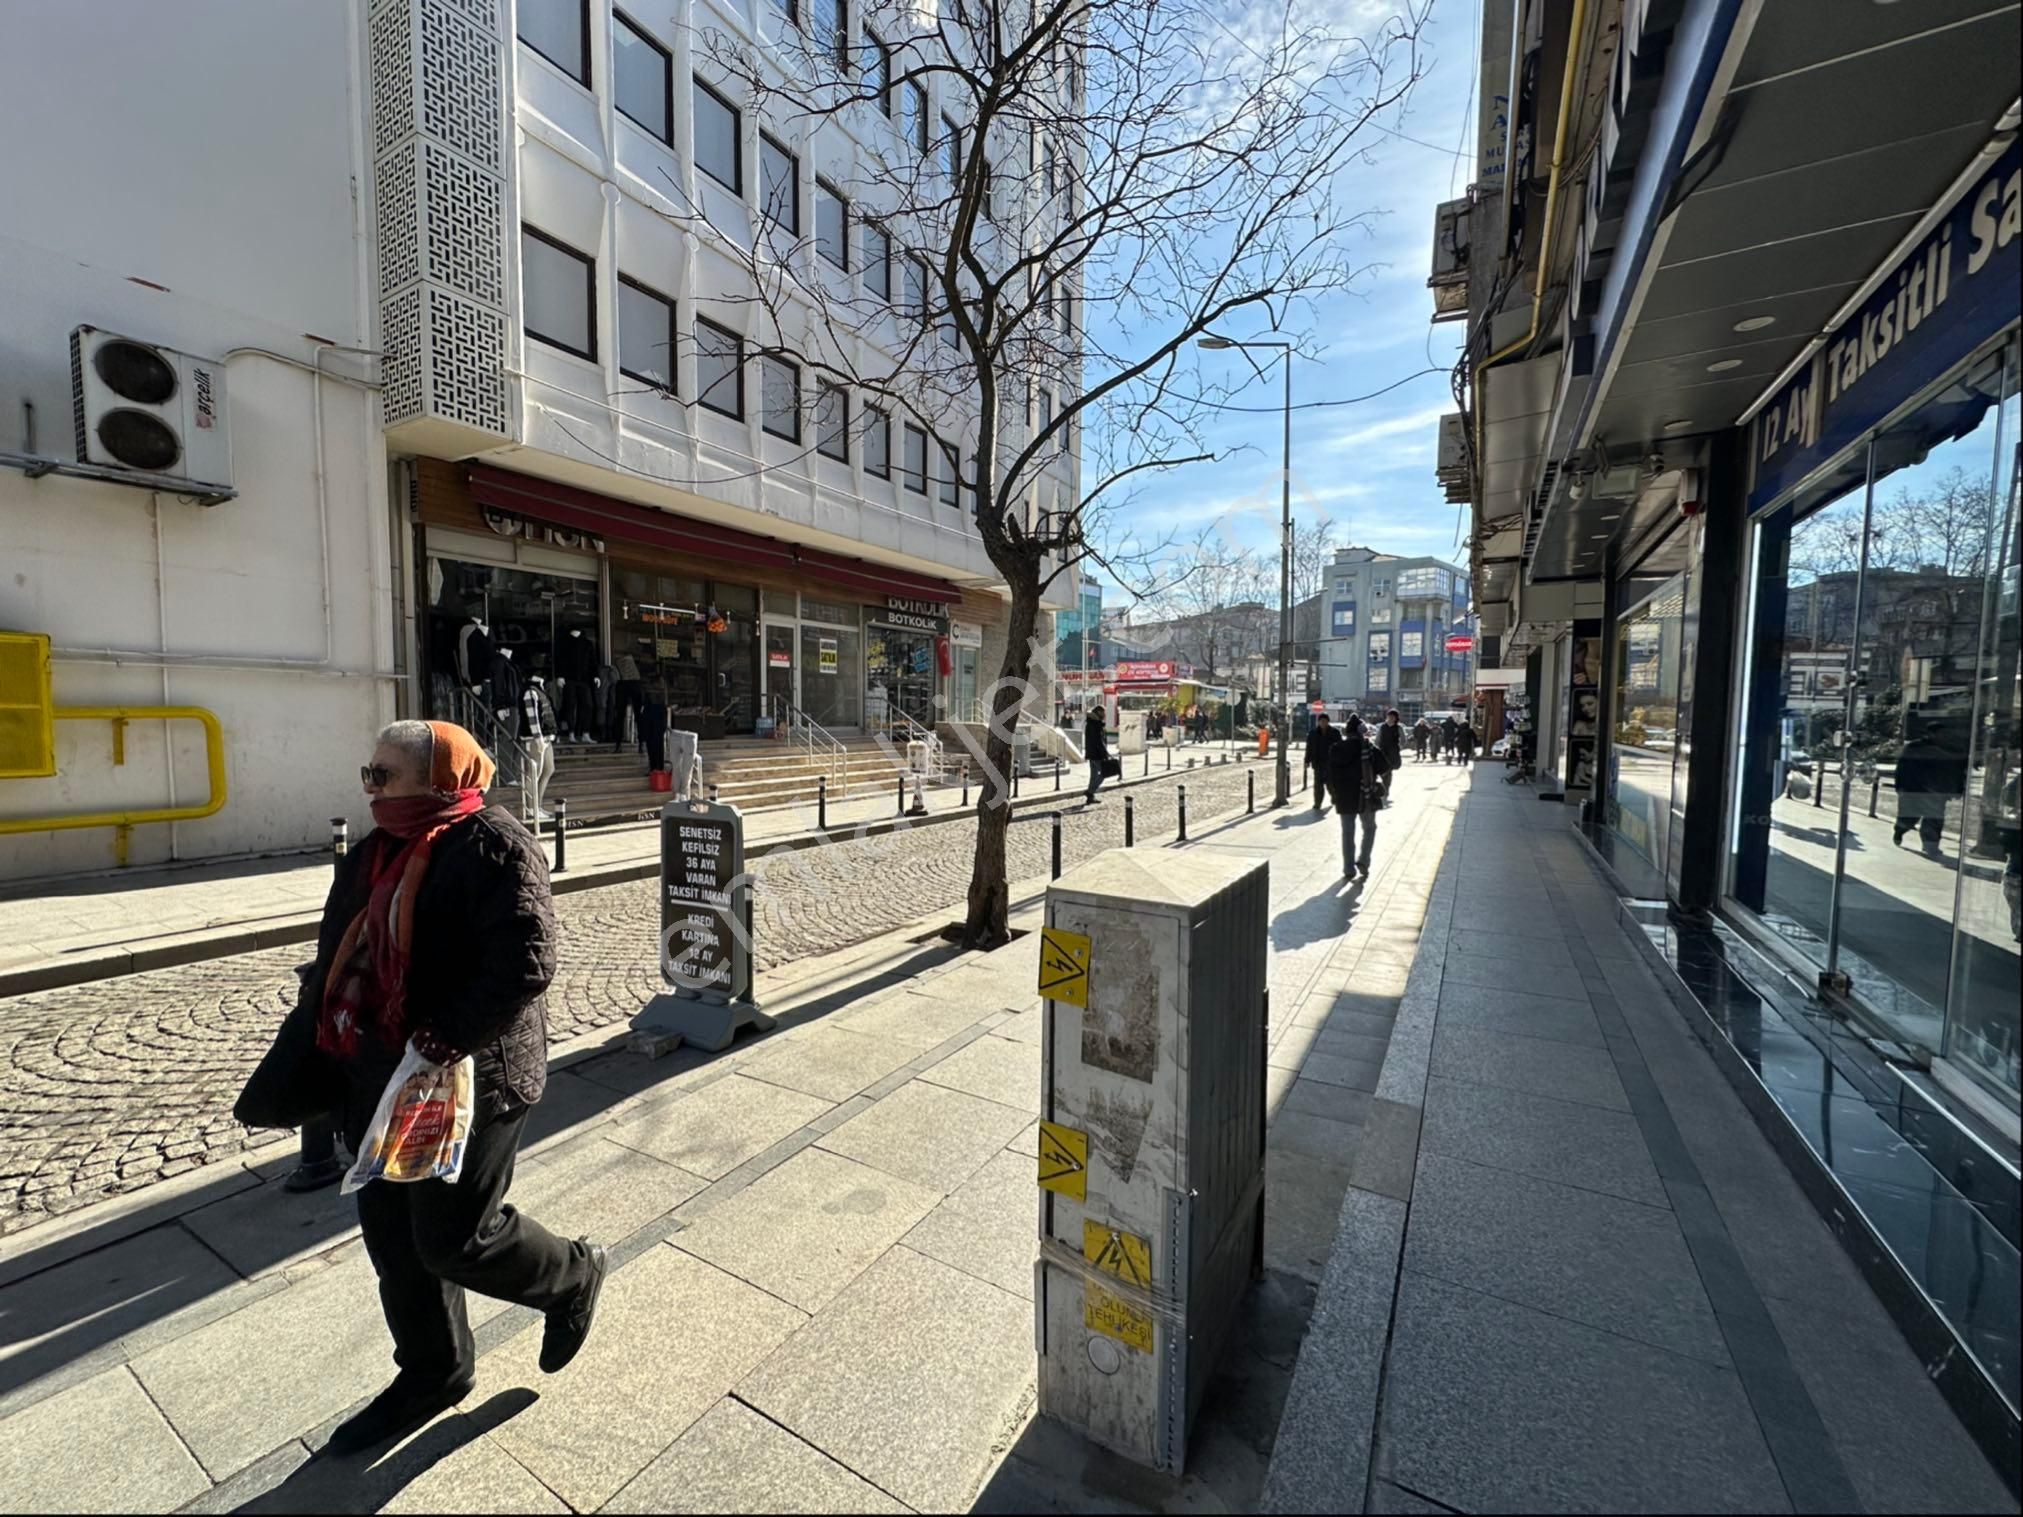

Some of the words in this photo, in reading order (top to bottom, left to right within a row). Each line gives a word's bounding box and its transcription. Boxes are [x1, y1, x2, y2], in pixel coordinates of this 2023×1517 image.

[1829, 222, 1953, 403] Taksitli
[679, 825, 722, 841] SENETSİZ
[682, 841, 720, 856] KEFİLSİZ
[686, 856, 699, 869] 36
[700, 858, 716, 871] AYA
[686, 871, 716, 886] VARAN
[668, 884, 700, 900] TAKSİT
[701, 886, 732, 906] İMKANI
[687, 912, 715, 929] KREDİ
[681, 929, 720, 947] KARTINA
[702, 950, 713, 963] AY
[668, 959, 698, 977] TAKSİT
[699, 962, 731, 985] İMKANI
